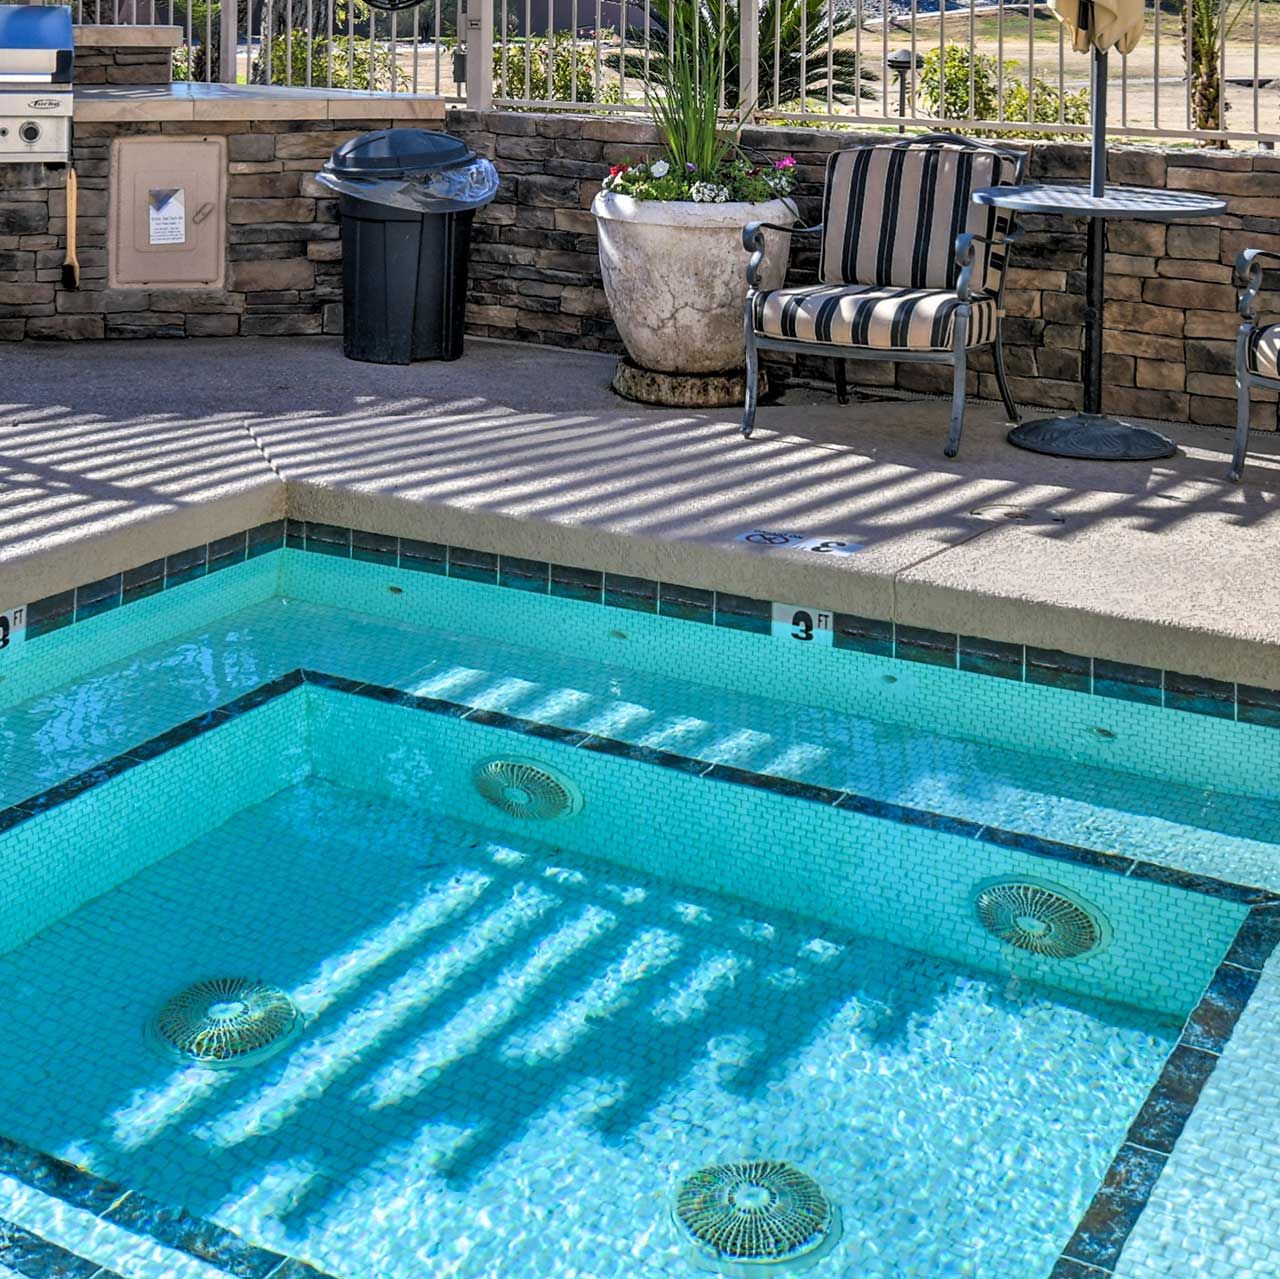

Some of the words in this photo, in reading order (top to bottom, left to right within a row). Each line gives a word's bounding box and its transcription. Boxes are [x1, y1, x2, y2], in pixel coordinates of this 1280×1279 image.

[13, 609, 24, 626] FT
[791, 610, 814, 641] 3
[817, 613, 830, 631] FT
